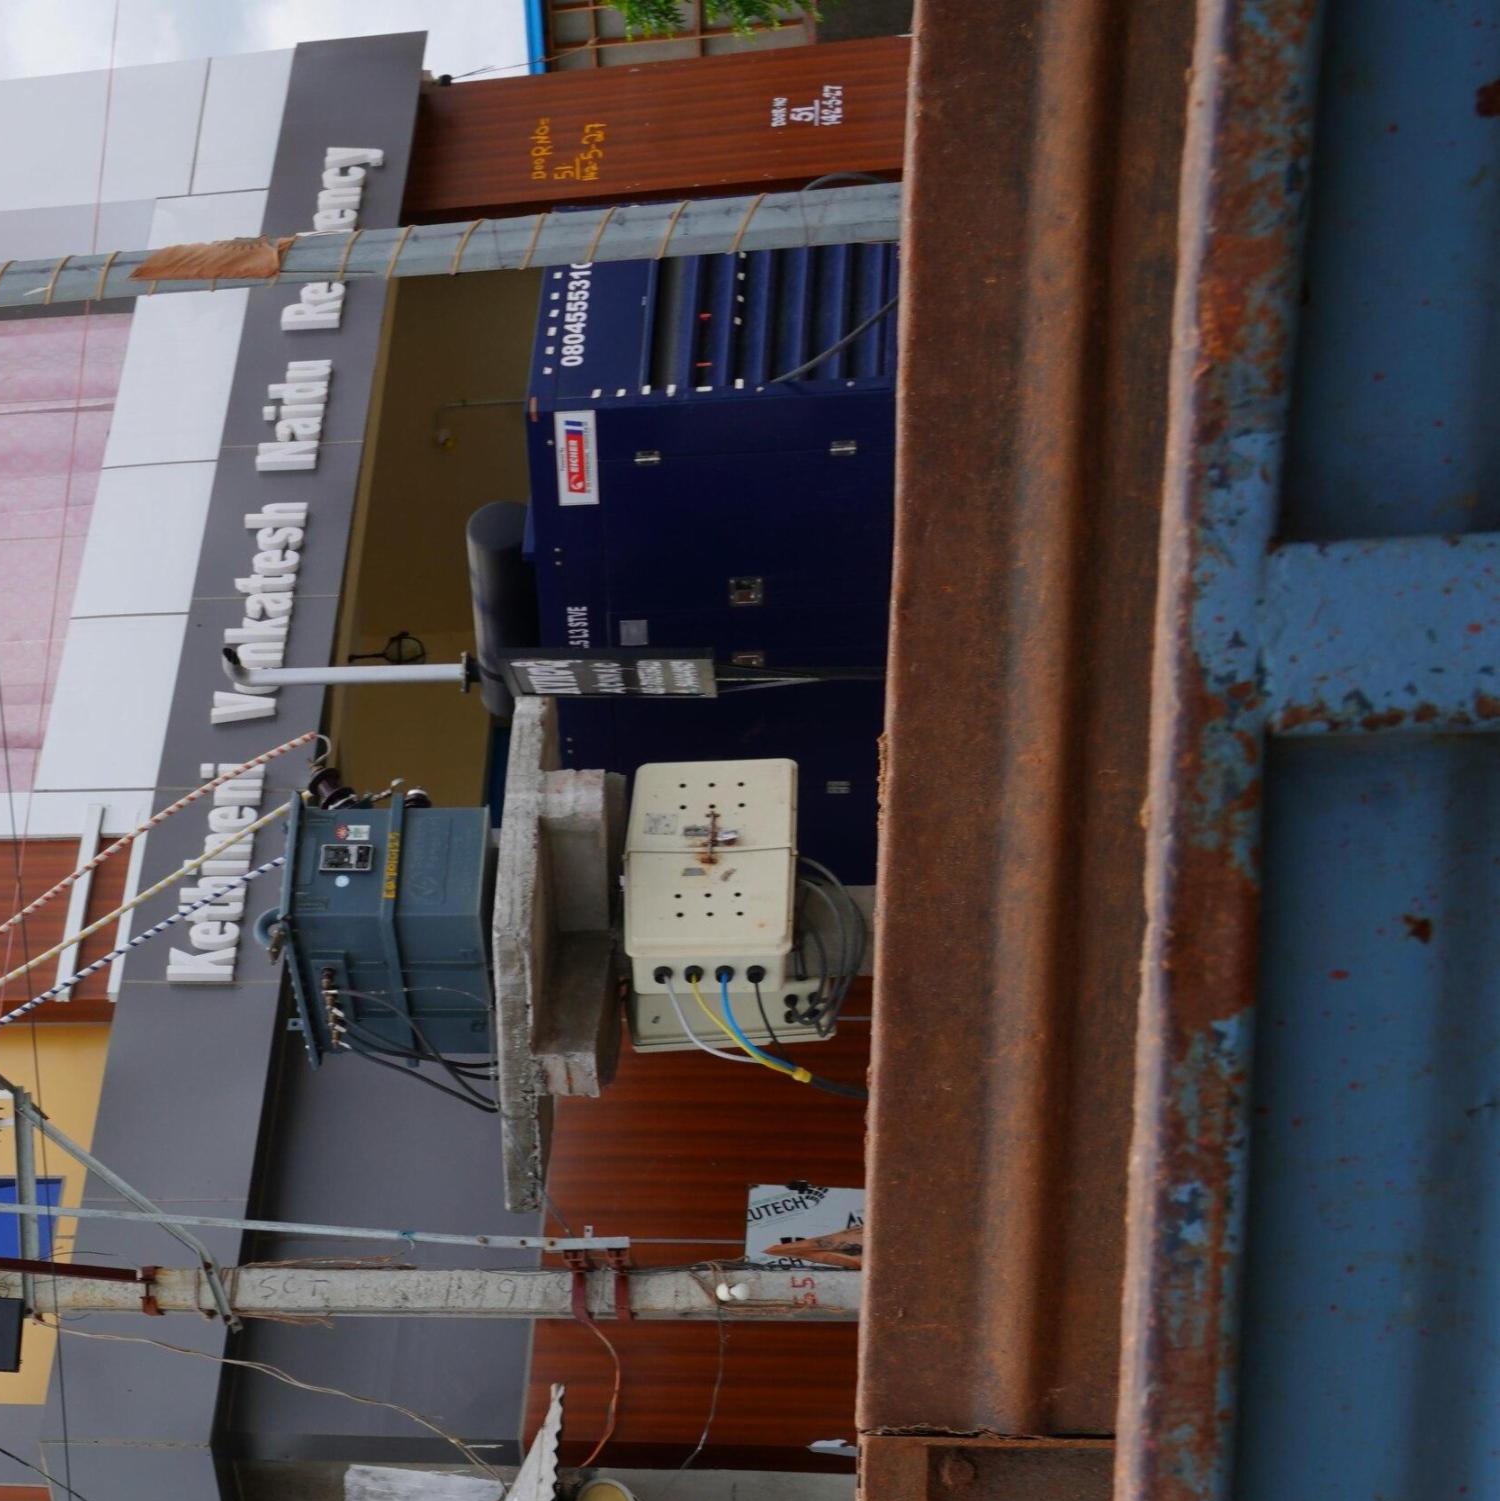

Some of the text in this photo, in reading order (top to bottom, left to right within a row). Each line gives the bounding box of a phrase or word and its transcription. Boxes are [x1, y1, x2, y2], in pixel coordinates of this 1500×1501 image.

[789, 106, 815, 122] 51
[280, 146, 384, 331] Reency
[255, 359, 333, 471] Naidu
[166, 762, 266, 982] Kethineni
[748, 1194, 810, 1223] UTECH
